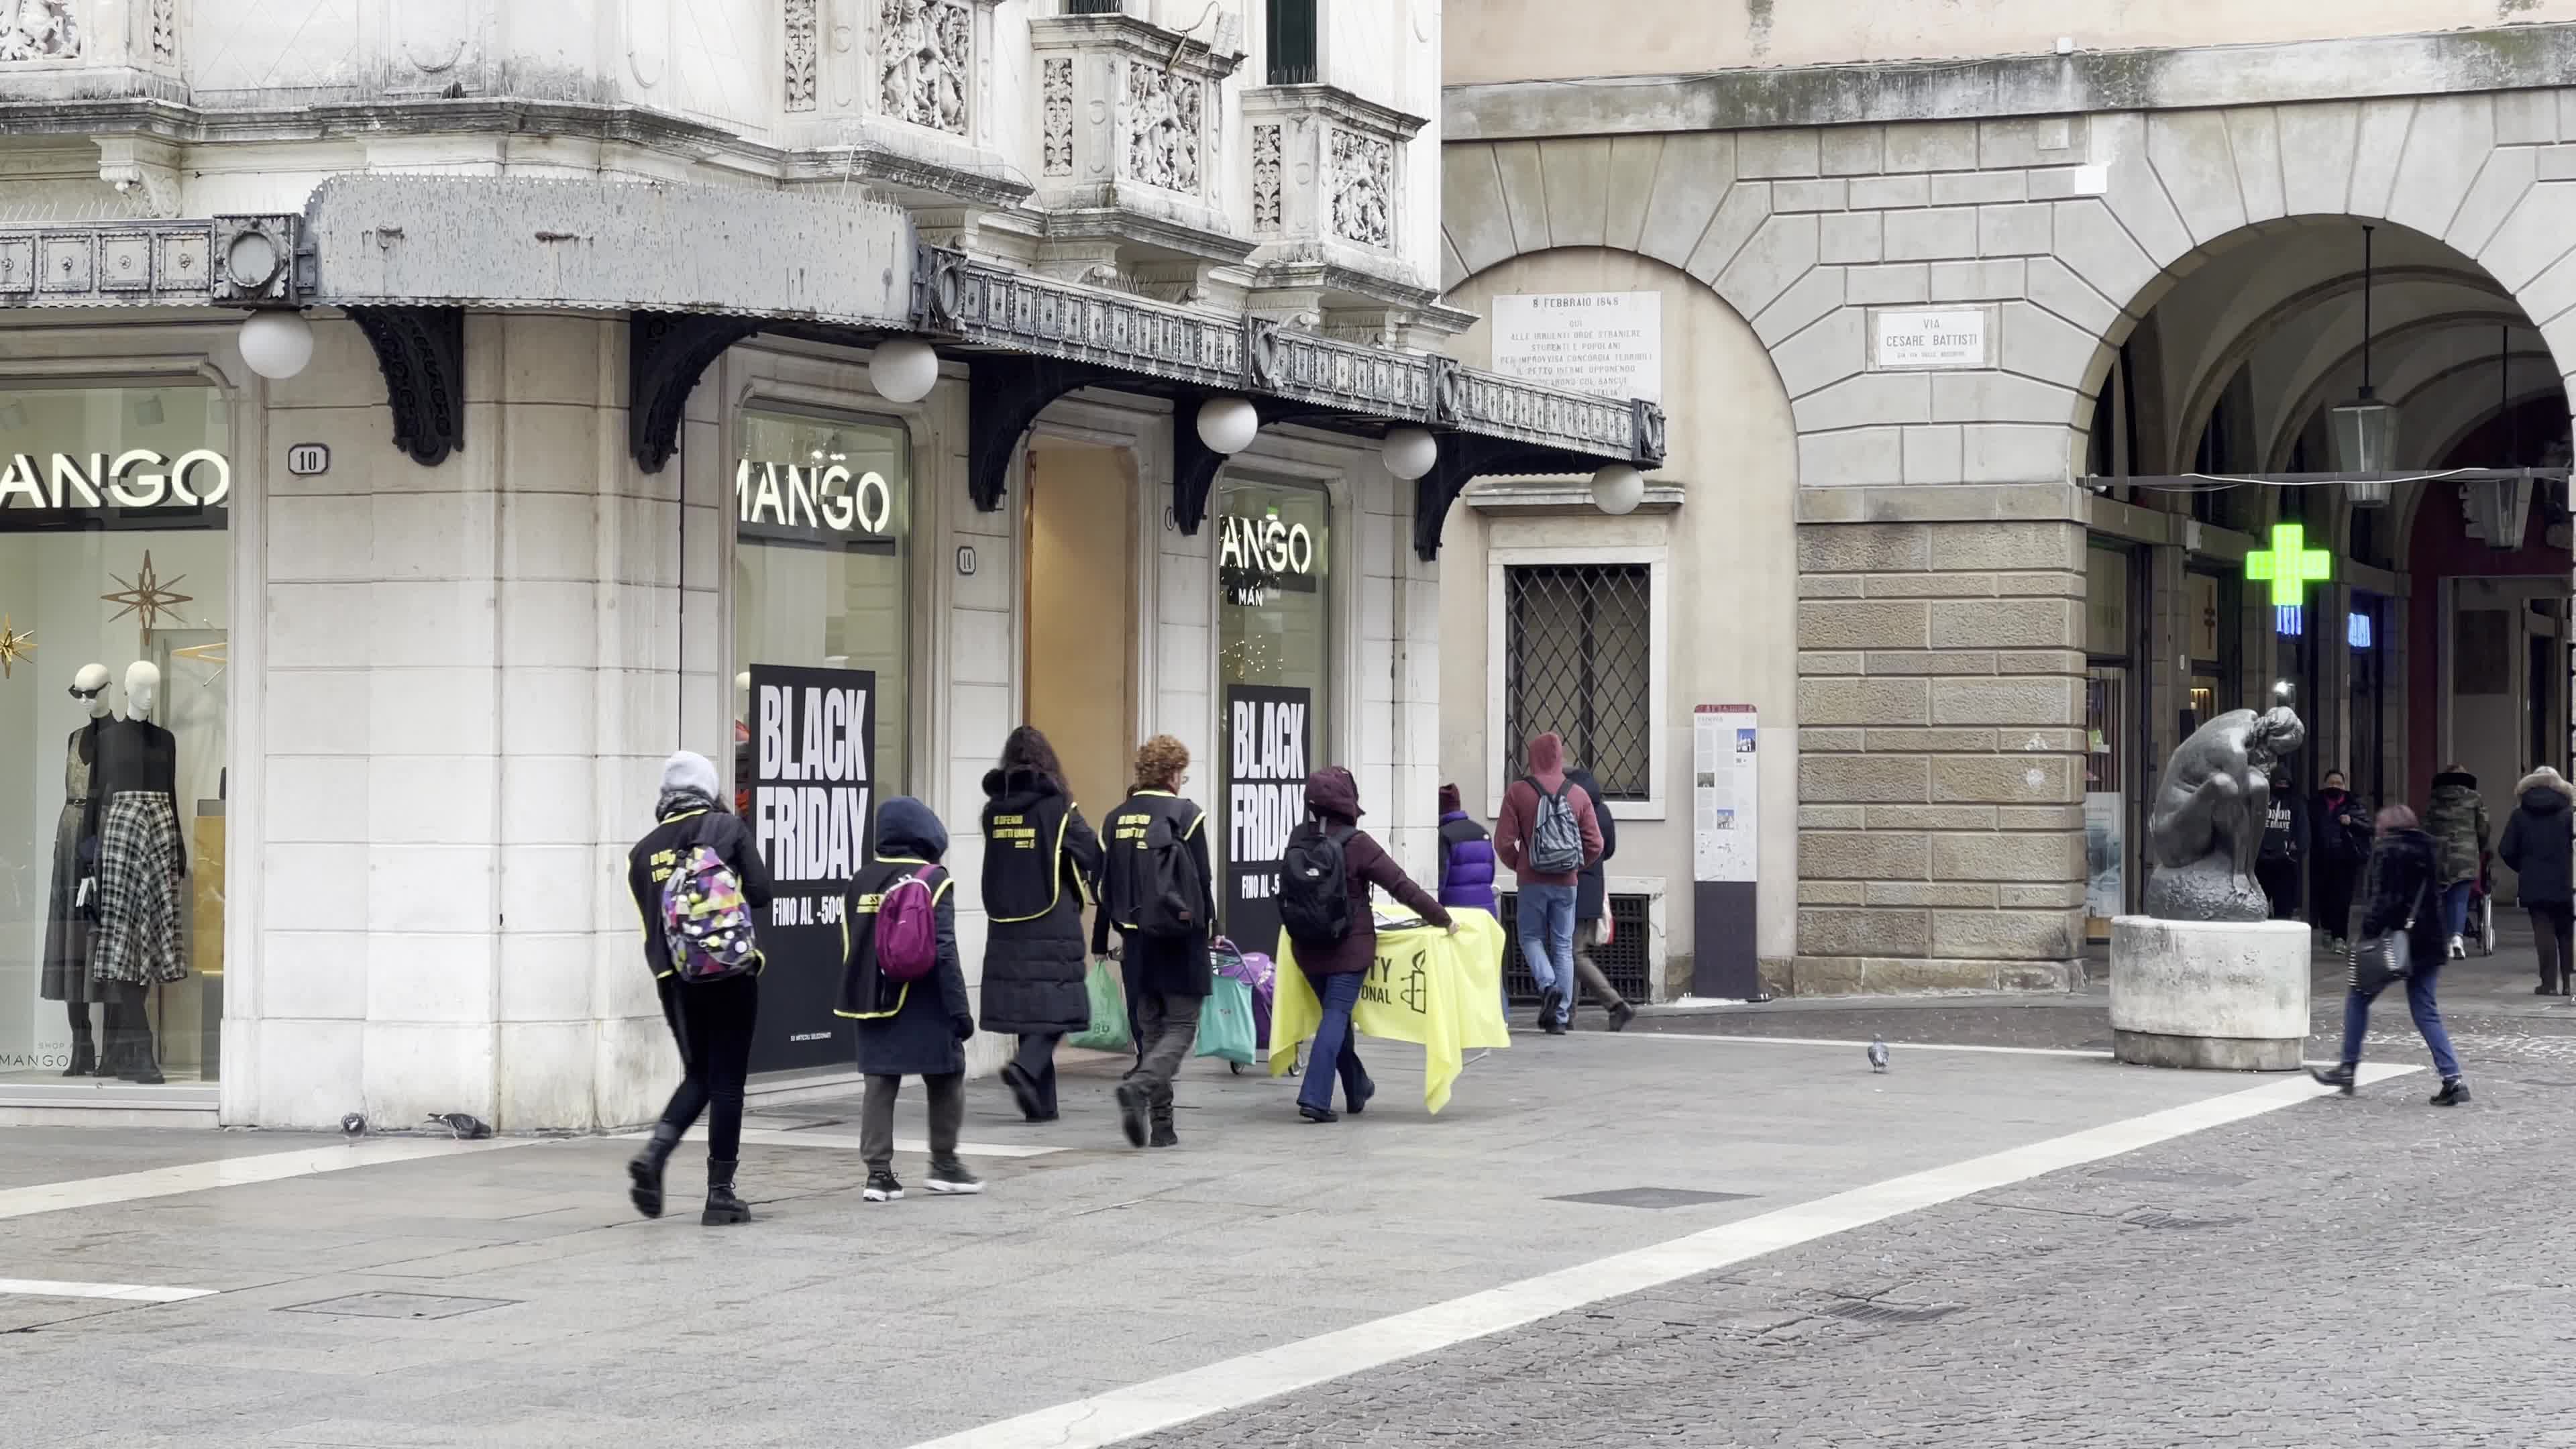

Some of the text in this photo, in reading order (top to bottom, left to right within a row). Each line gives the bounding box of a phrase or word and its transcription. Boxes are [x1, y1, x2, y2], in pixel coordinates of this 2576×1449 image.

[1544, 298, 1591, 308] FEBBRAIO
[1923, 319, 1940, 329] VIA
[1886, 334, 1977, 347] CESARE BATTISTI
[299, 451, 316, 471] 10
[0, 449, 229, 508] ANGO
[1220, 517, 1311, 574] ANGO
[1238, 588, 1263, 606] MAN
[759, 685, 867, 782] BLACK
[1233, 701, 1305, 779] BLACK
[756, 786, 869, 881] FRIDAY
[1231, 784, 1306, 862] FRIDAY
[1242, 873, 1280, 899] FINO AL -5
[773, 897, 797, 926] FINO
[800, 896, 814, 925] AL
[1369, 957, 1392, 983] TY
[1361, 985, 1391, 1004] ONAL
[38, 1041, 64, 1050] SHOP
[0, 1054, 68, 1067] MANGO
